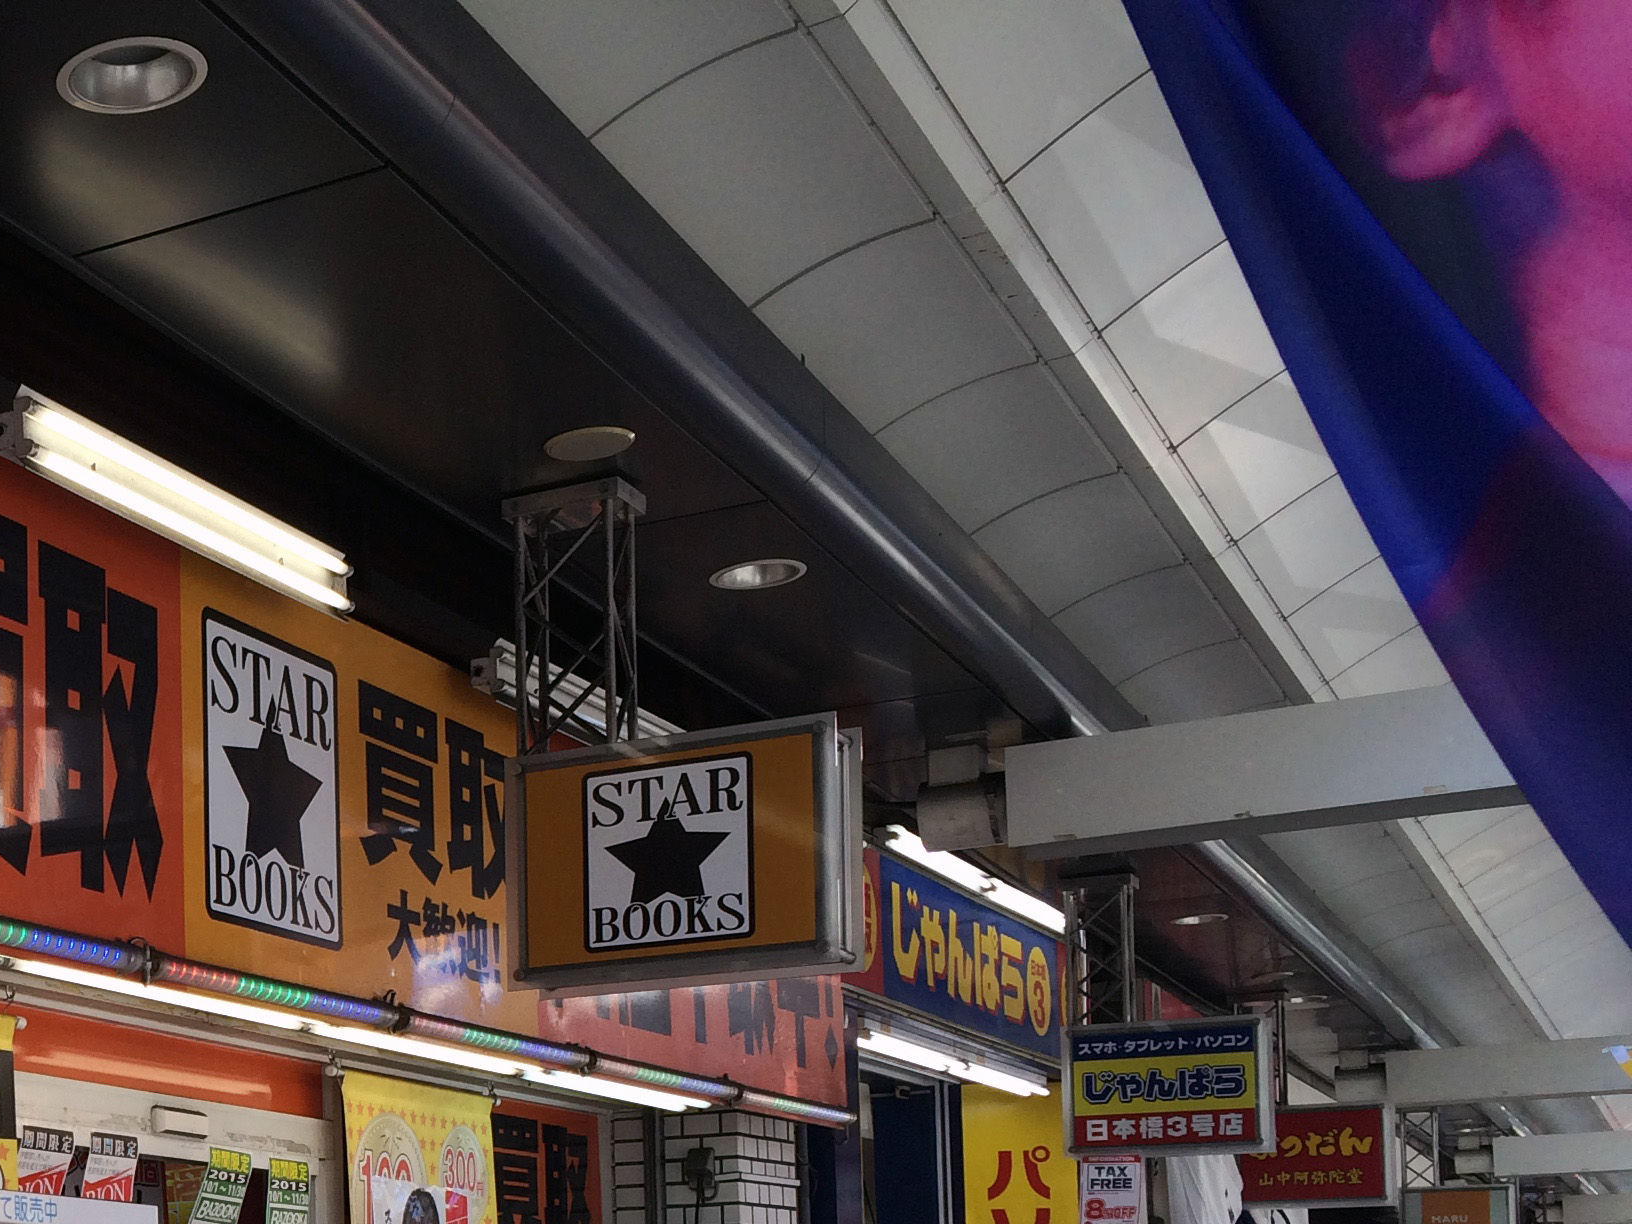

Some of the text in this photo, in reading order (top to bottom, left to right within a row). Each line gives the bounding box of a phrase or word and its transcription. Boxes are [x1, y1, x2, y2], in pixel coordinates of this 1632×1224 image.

[210, 635, 332, 752] STAR
[358, 680, 505, 900] 買取
[590, 765, 744, 829] STAR
[212, 843, 336, 937] BOOKS
[592, 892, 746, 945] BOOKS
[891, 881, 1026, 1026] じゃんぱら
[1033, 980, 1046, 1029] 3
[1082, 1064, 1248, 1104] じゃんぱら
[22, 1129, 74, 1154] 期間限定
[1085, 1113, 1244, 1142] 日本橋3号店
[91, 1136, 138, 1159] 期間限定
[209, 1169, 246, 1184] 2015
[271, 1179, 308, 1191] 2015
[1090, 1178, 1133, 1190] FREE
[1094, 1165, 1128, 1178] TAX
[1258, 1168, 1364, 1187] 山中阿弥陀堂
[196, 1199, 241, 1221] BAZOOKA
